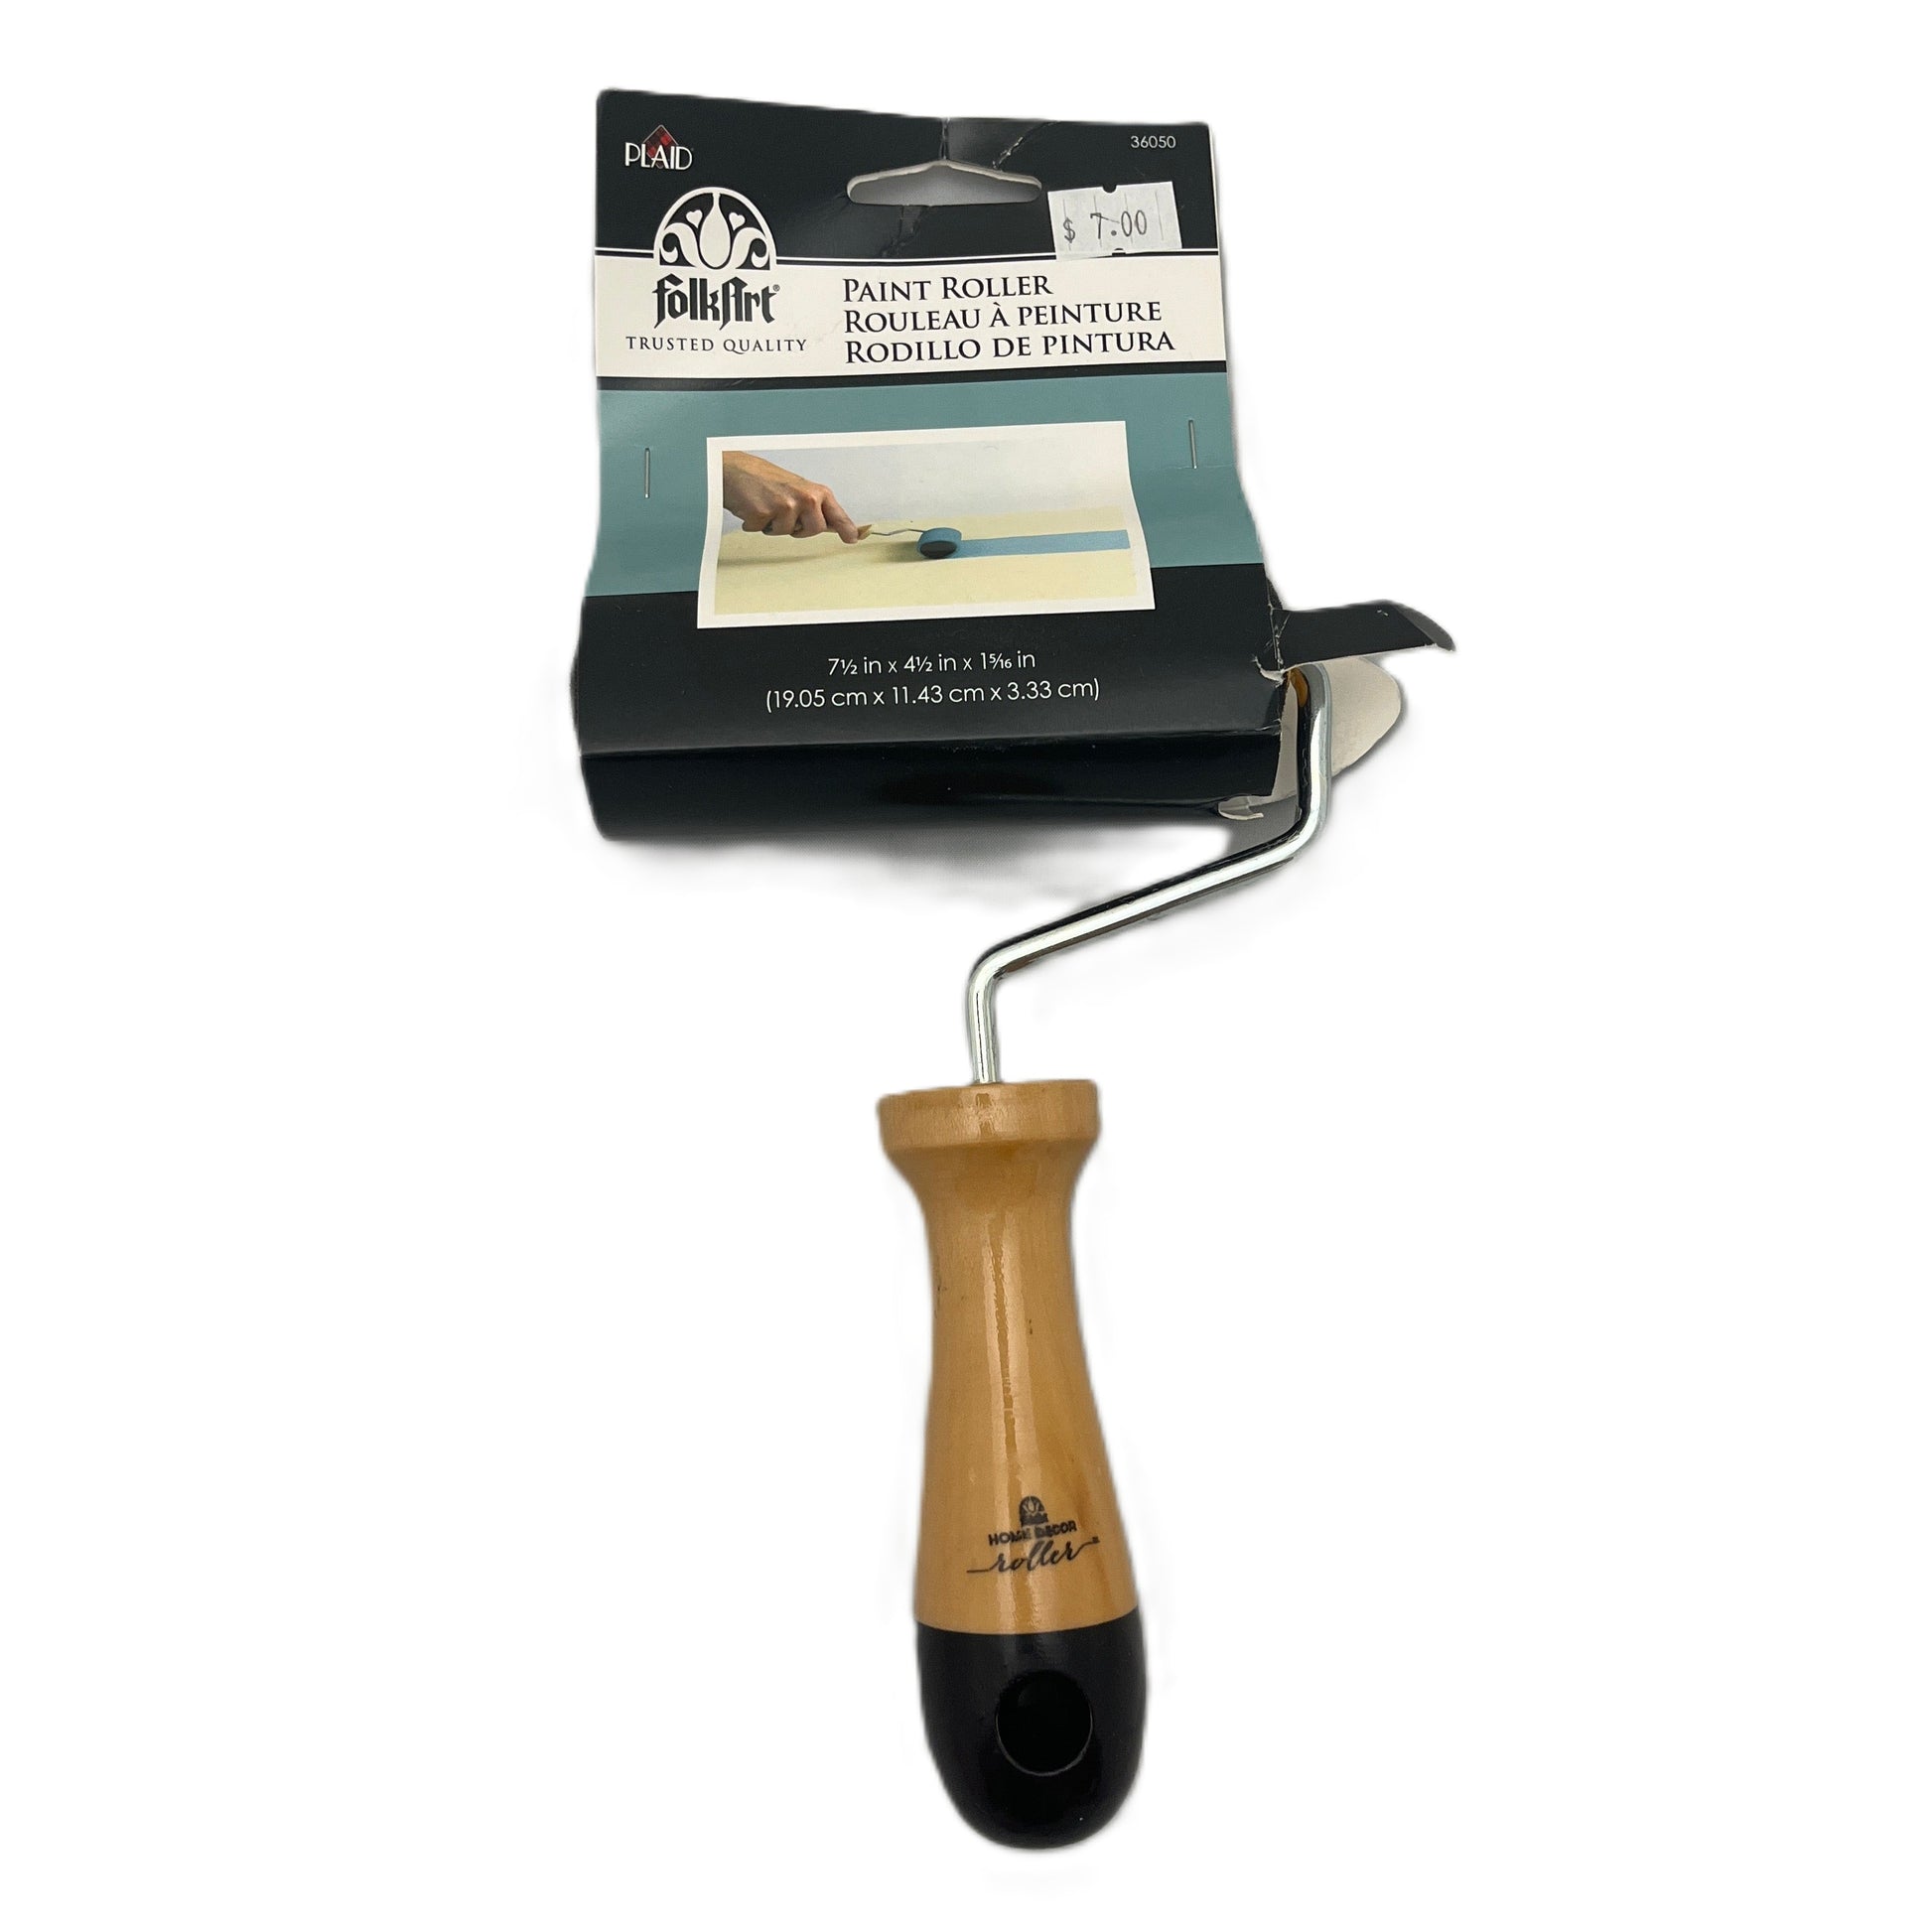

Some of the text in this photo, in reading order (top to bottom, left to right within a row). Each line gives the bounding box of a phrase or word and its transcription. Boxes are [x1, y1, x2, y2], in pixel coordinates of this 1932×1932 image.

[624, 142, 693, 171] PLAID
[1130, 135, 1176, 149] 36050
[1090, 209, 1148, 239] 7.00
[843, 275, 1053, 302] PAINT ROLLER
[844, 301, 1162, 334] ROULEAU À PEINTURE
[625, 336, 807, 354] TRUSTED QUALITY
[846, 331, 1175, 363] RODILLO DE PINTURA
[863, 656, 882, 674] in
[888, 659, 897, 673] x
[938, 653, 957, 671] in
[963, 657, 973, 670] x
[1017, 650, 1035, 668] in
[766, 678, 1099, 713] (19.05 cm x 11.43 cm x 3.33 cm)
[966, 1539, 1093, 1573] roller
